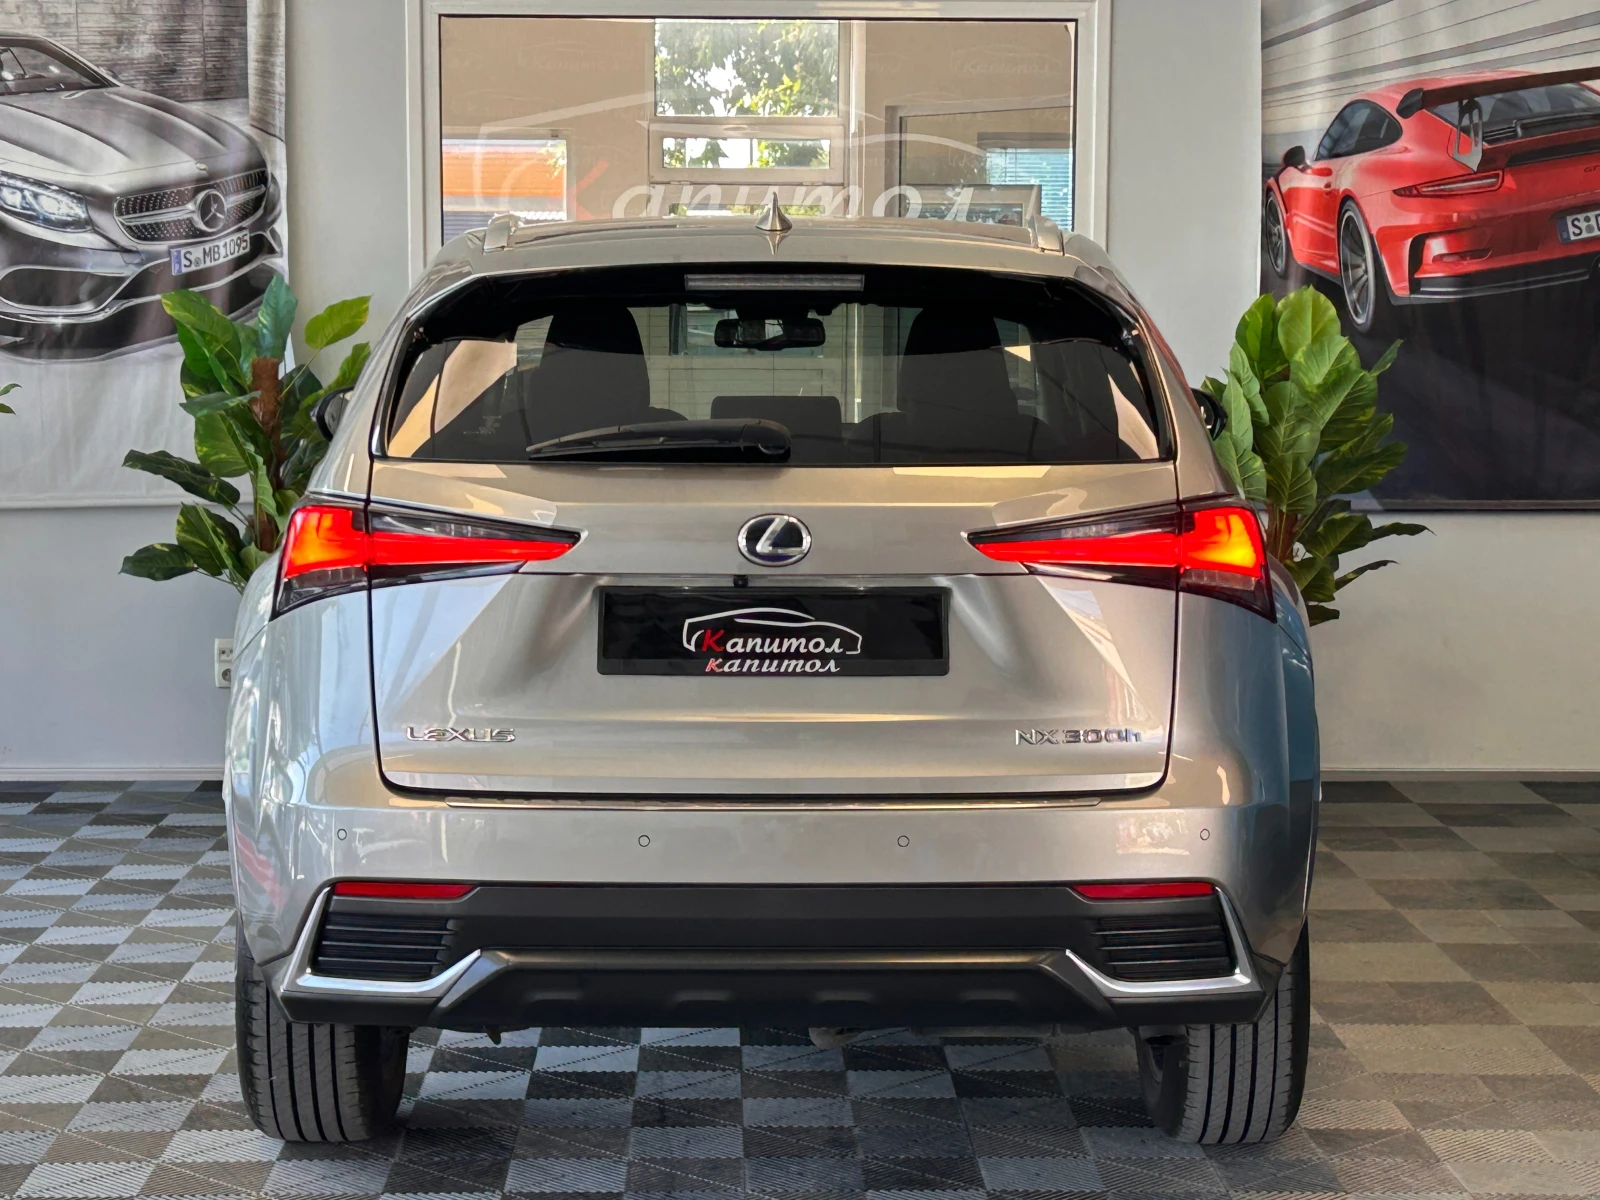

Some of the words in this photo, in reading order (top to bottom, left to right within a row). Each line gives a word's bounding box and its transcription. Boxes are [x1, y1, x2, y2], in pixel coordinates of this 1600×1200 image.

[1571, 217, 1583, 237] S
[183, 250, 193, 268] S
[203, 245, 221, 265] MB
[222, 233, 248, 259] 1095
[701, 629, 843, 653] Капитол
[406, 727, 516, 742] LEXUS
[1015, 729, 1060, 745] NX
[1062, 728, 1142, 744] 300h
